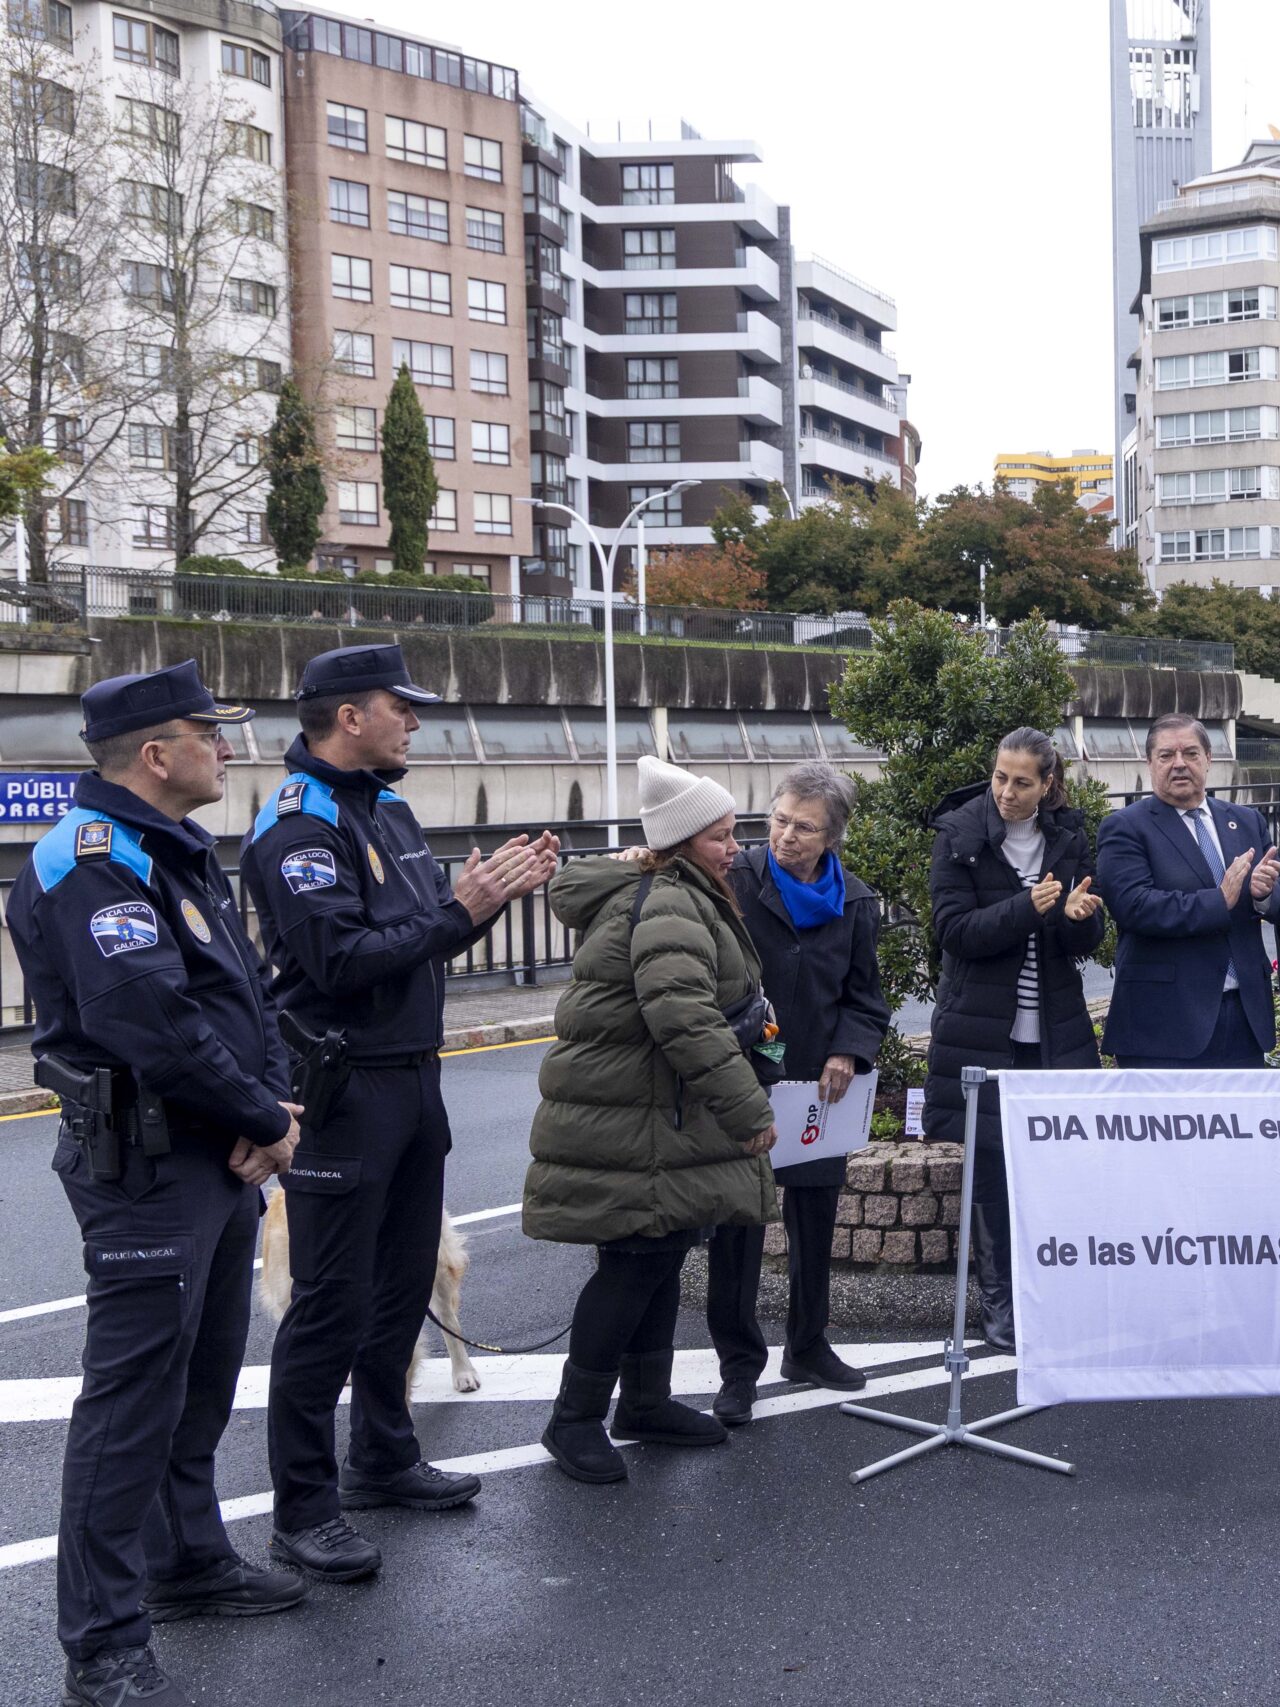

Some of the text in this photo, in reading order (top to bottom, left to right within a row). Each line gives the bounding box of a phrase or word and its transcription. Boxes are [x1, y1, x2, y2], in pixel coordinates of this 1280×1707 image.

[124, 906, 150, 914] LOCAL
[113, 940, 145, 950] GALICIA
[1027, 1114, 1088, 1142] DIA
[1095, 1113, 1253, 1142] MUNDIAL
[145, 1248, 176, 1258] LOCAL
[1036, 1236, 1078, 1267] de
[1087, 1235, 1136, 1266] las
